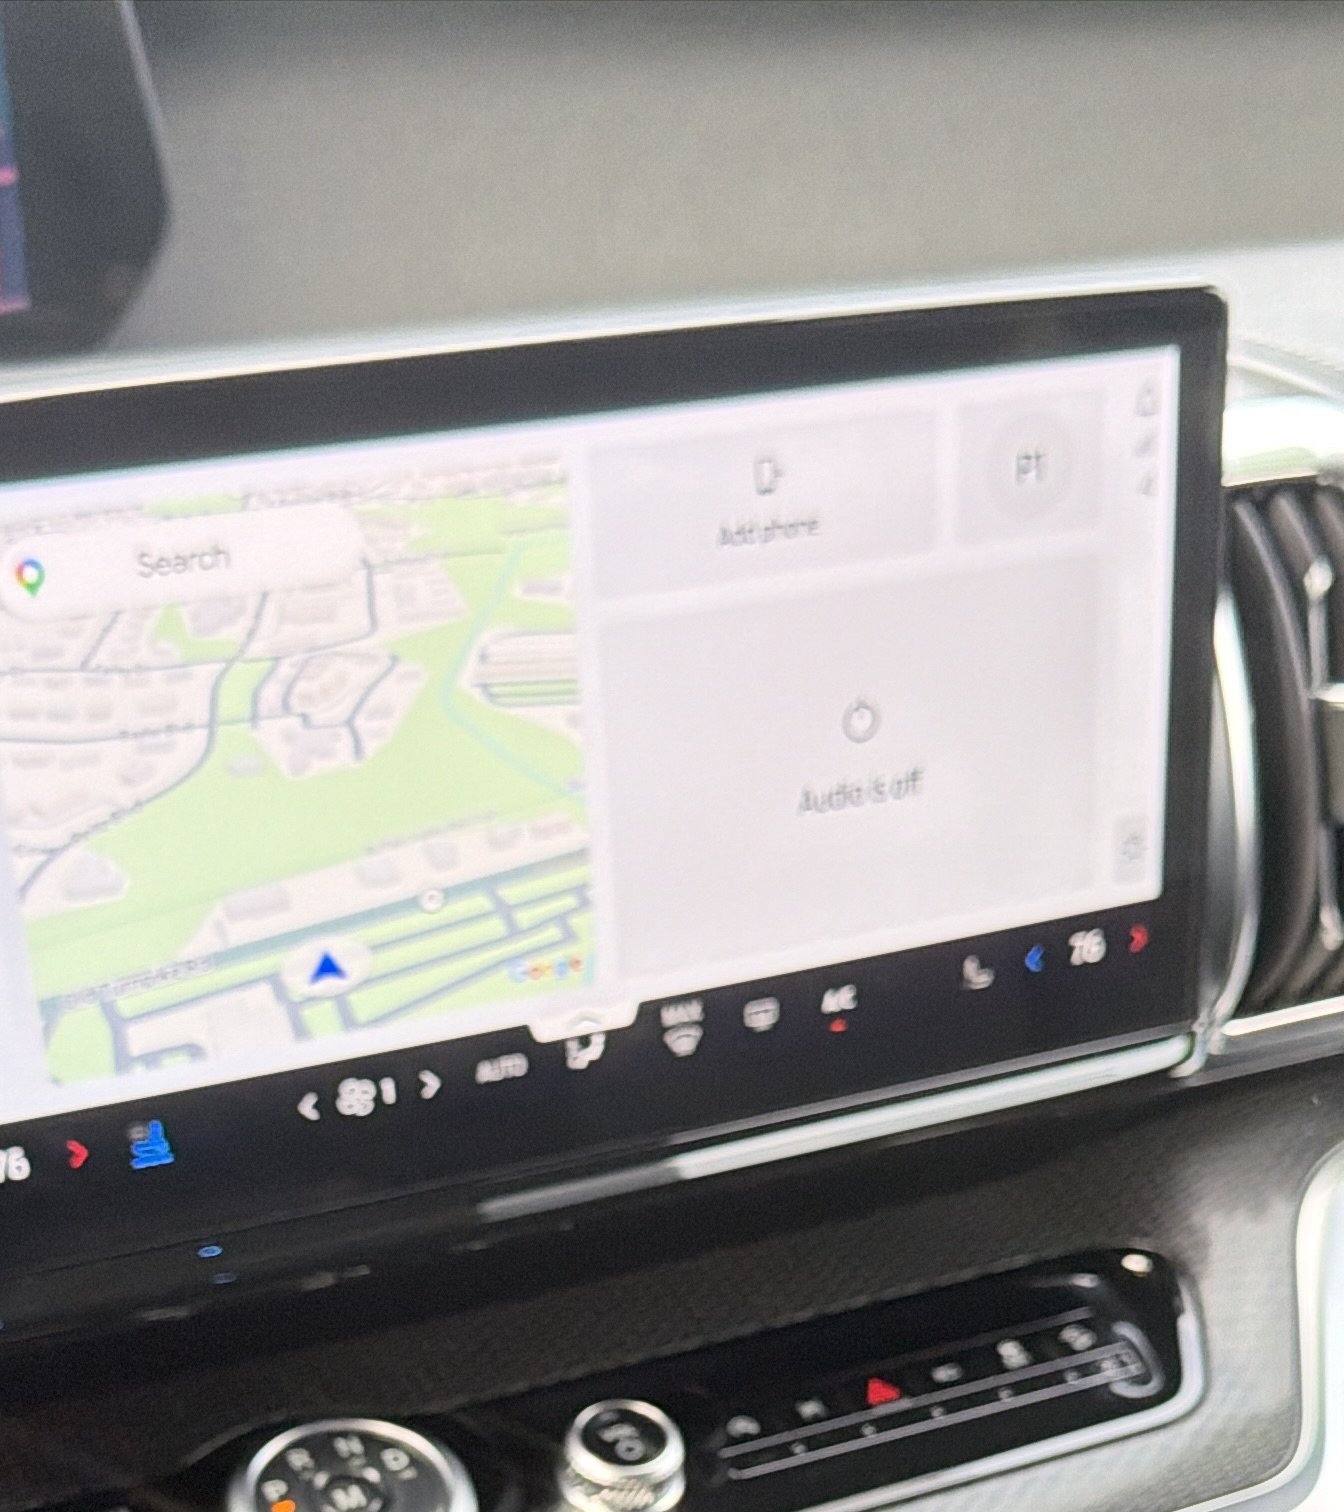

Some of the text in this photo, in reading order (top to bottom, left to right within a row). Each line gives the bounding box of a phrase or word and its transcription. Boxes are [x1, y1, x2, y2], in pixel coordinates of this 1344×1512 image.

[137, 544, 231, 579] Search
[798, 784, 865, 815] Audio
[890, 766, 925, 800] off
[1069, 928, 1106, 966] 76
